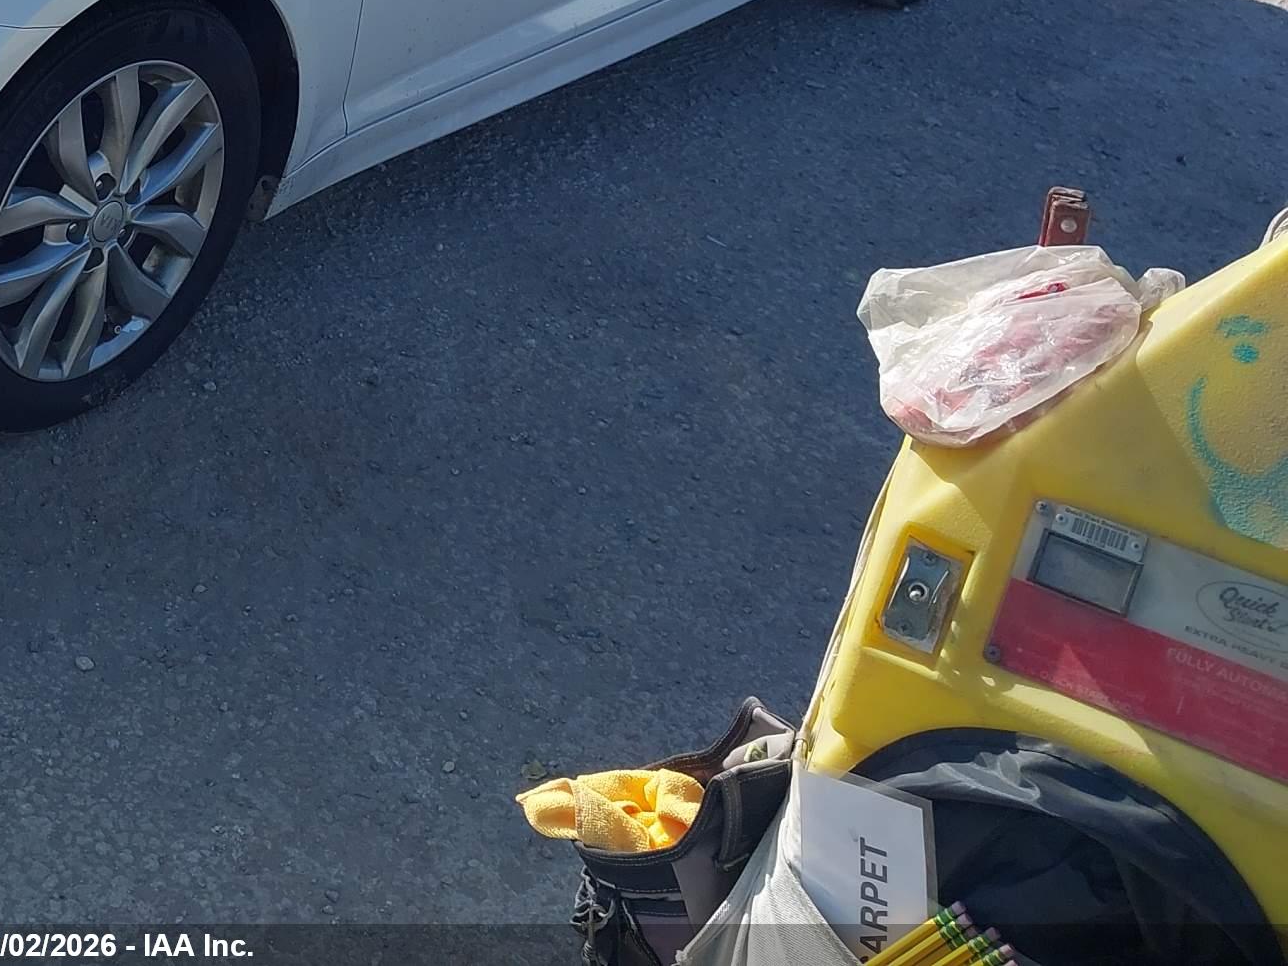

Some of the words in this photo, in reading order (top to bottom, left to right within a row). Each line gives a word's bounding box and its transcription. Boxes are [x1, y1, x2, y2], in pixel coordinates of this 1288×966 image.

[1219, 586, 1280, 618] Quick
[1184, 625, 1227, 647] EXTRA
[1167, 647, 1214, 673] FULLY
[859, 836, 888, 965] ARPET
